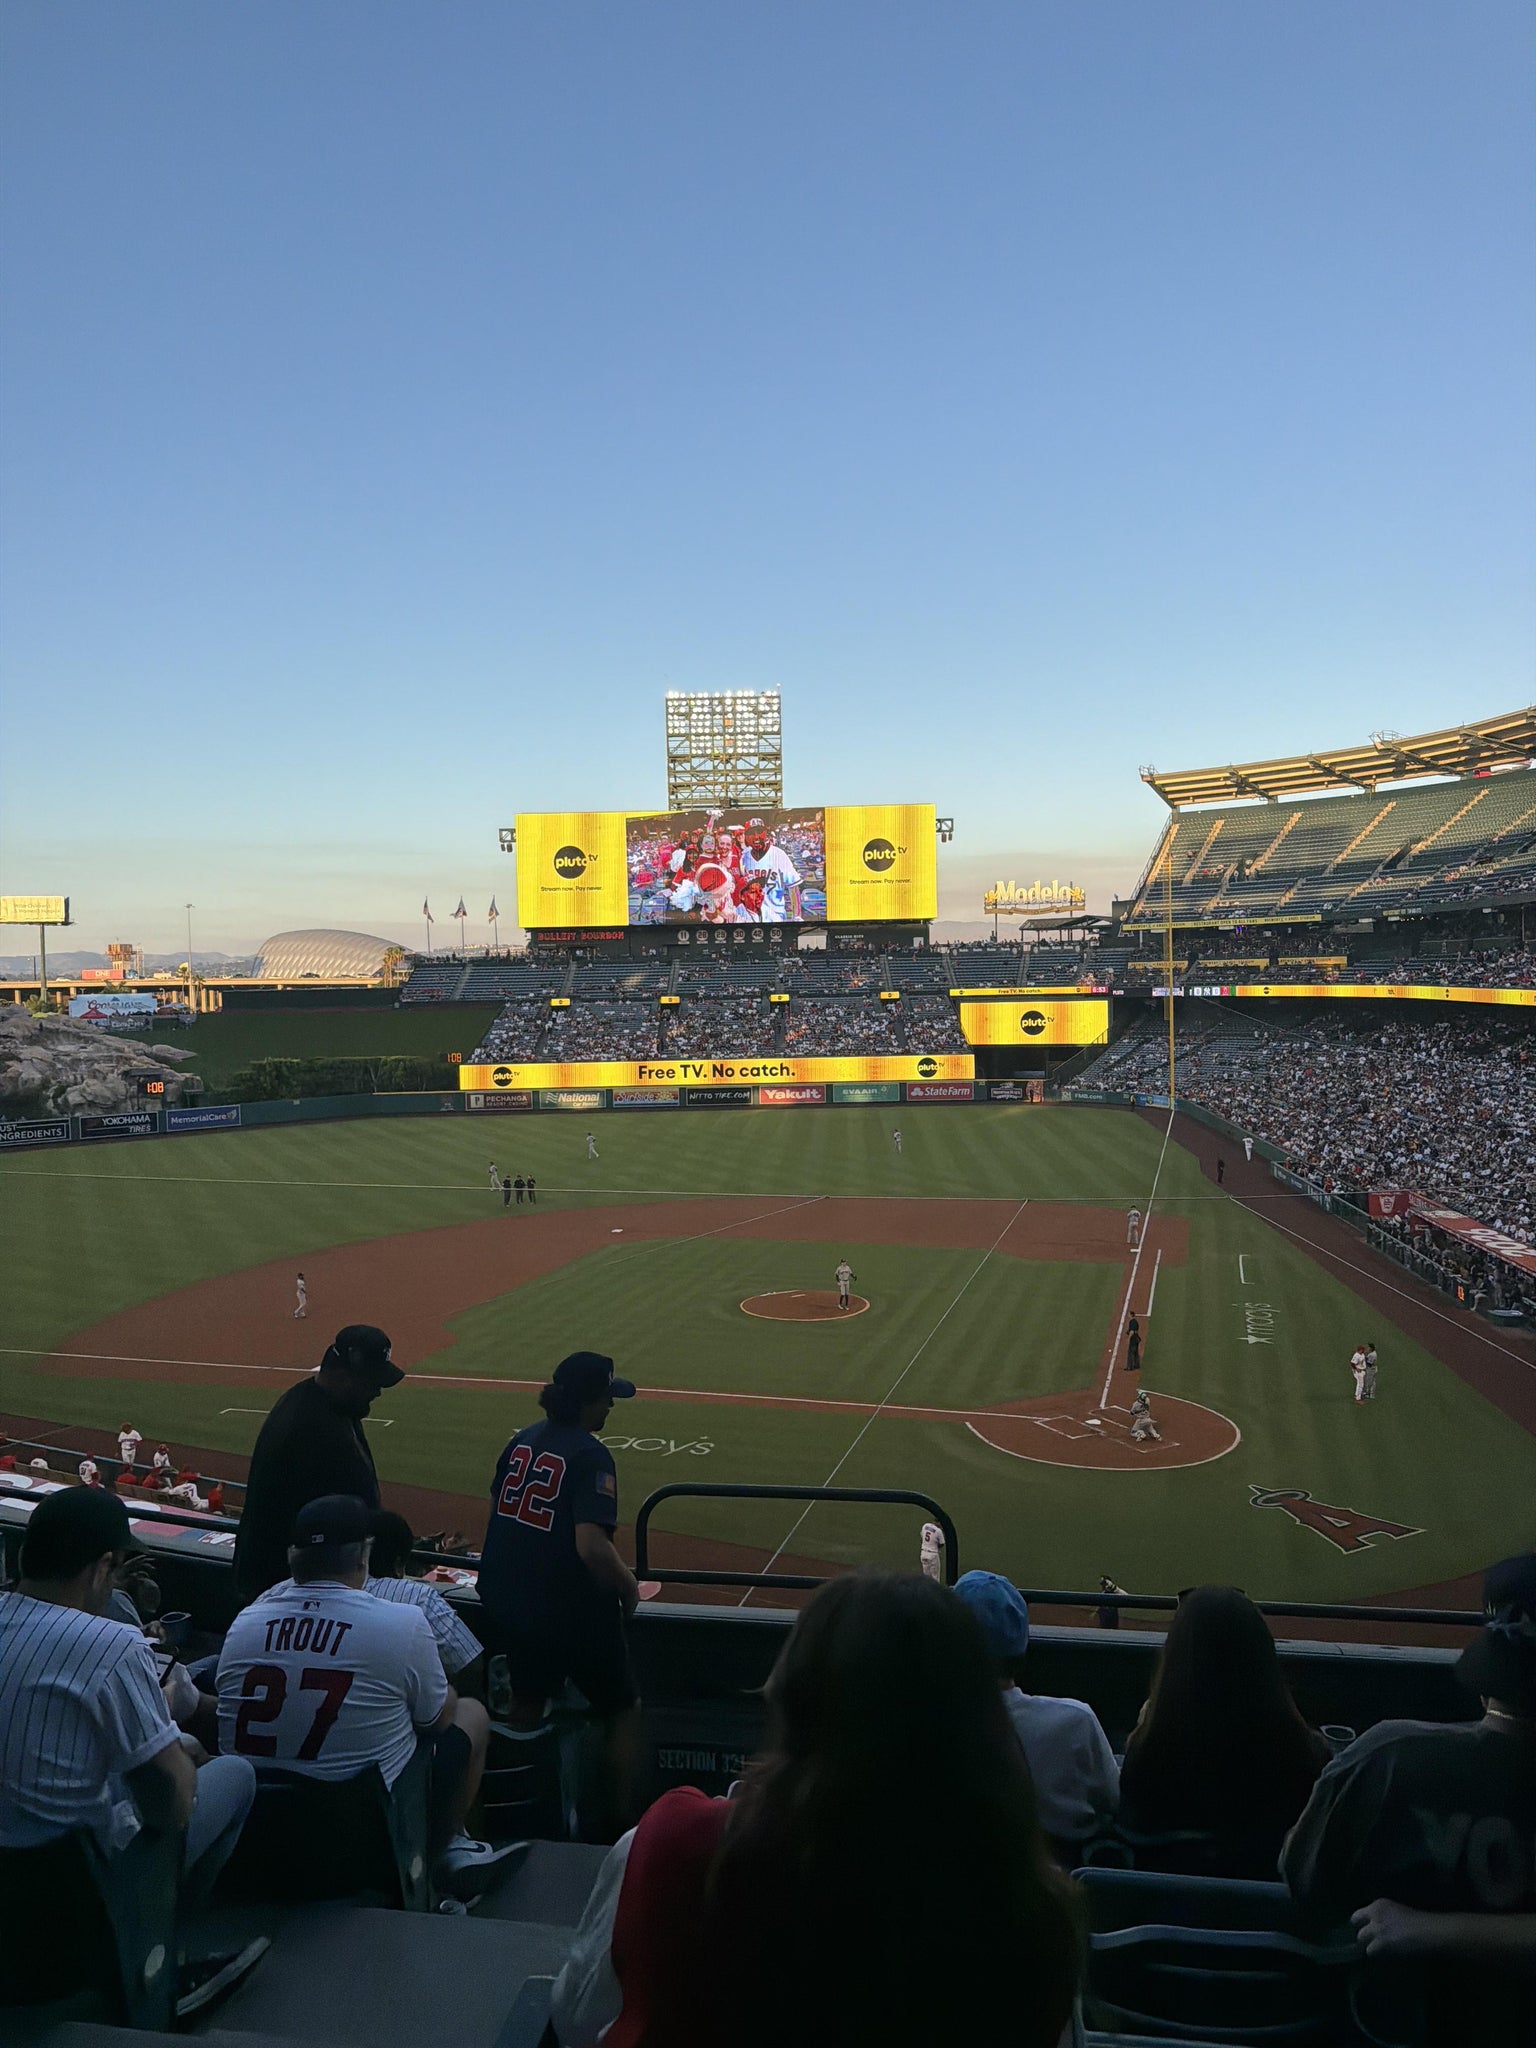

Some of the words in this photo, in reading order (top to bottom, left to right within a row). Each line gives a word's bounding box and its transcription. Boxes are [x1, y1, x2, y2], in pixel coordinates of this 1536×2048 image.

[864, 850, 896, 862] pluto
[555, 856, 587, 869] pluto
[996, 879, 1071, 904] Modelo
[581, 932, 624, 940] BOURBON
[1021, 1018, 1046, 1028] pluto
[638, 1066, 676, 1080] Free
[680, 1064, 708, 1078] TV.
[712, 1064, 735, 1078] No
[739, 1063, 796, 1077] catch.
[918, 1064, 938, 1072] pluto
[493, 1072, 514, 1081] pluto
[689, 1092, 712, 1100] NITTO
[764, 1089, 821, 1099] Yakult
[924, 1087, 947, 1096] State
[948, 1086, 970, 1096] Farm
[558, 1092, 600, 1102] National
[102, 1116, 150, 1126] YOKOHAMA
[171, 1113, 226, 1124] MemorialCare
[129, 1125, 151, 1133] TIRES
[598, 1435, 715, 1456] acy's
[497, 1445, 567, 1532] 22
[925, 1532, 931, 1542] 5
[265, 1616, 352, 1656] TROUT
[234, 1664, 356, 1761] 27
[658, 1748, 716, 1772] SECTION
